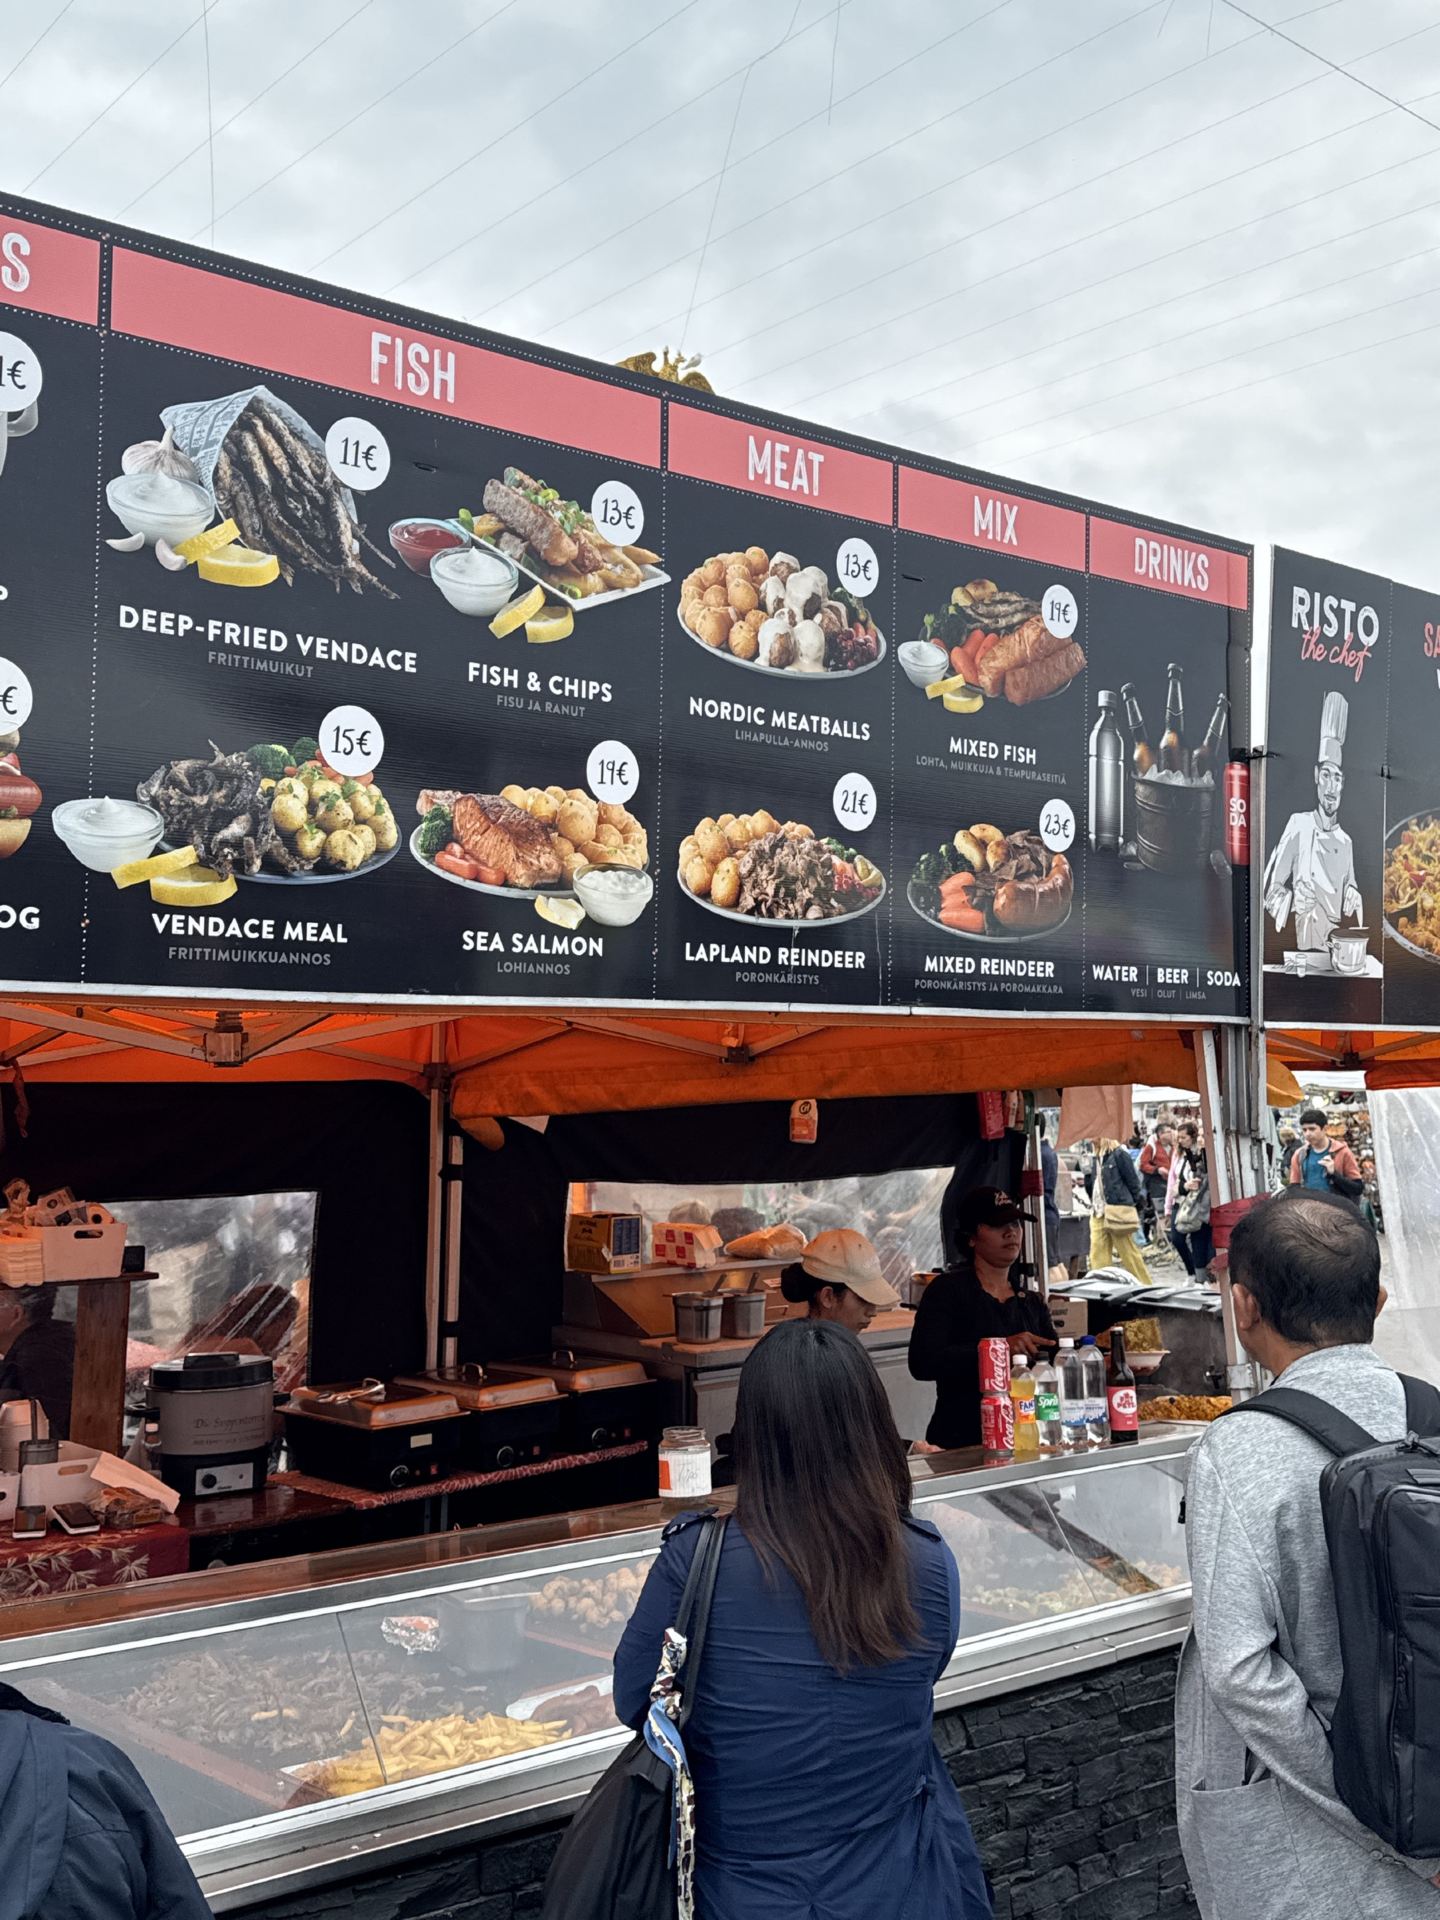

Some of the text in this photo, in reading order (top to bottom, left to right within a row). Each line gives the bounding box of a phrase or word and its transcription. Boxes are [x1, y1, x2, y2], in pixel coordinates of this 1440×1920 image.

[371, 331, 455, 403] FISH
[341, 438, 377, 471] 11€
[748, 435, 825, 496] MEAT
[602, 498, 635, 530] 13€
[974, 495, 1018, 546] MIX
[845, 554, 872, 581] 13€
[1134, 537, 1209, 592] DRINKS
[1047, 602, 1071, 623] 19€
[1291, 586, 1380, 647] RISTO
[119, 604, 417, 676] DEEP-FRIED VENDACE
[208, 651, 314, 678] FRITTIMUIKUT
[1301, 626, 1372, 683] the chef
[468, 661, 613, 703] FISH & CHIPS
[496, 694, 586, 717] FISU JA RANUT
[689, 696, 871, 741] NORDIC MEATBALLS
[331, 725, 371, 756] 15€
[735, 729, 830, 752] LIHAPULLA-ANNOS
[949, 736, 1036, 765] MIXED FISH
[598, 759, 629, 786] 19€
[915, 754, 948, 770] LOHTA,
[950, 760, 995, 775] MUIKKUJA
[841, 790, 868, 815] 21€
[1229, 797, 1247, 813] SO
[1044, 812, 1070, 838] 23€
[1229, 812, 1247, 828] DA
[151, 913, 348, 943] VENDACE MEAL
[168, 946, 331, 966] FRITTIMUIKKUANNOS
[462, 930, 603, 957] SEA SALMON
[685, 942, 866, 969] LAPLAND REINDEER
[497, 961, 571, 975] LOHIANNOS
[735, 969, 819, 985] PORONKÄRISTYS
[924, 955, 1055, 978] MIXED REINDEER
[1092, 964, 1241, 987] WATER BEER SODA
[914, 978, 1064, 994] PORONKÄRISTYS JA POROMAKKARA
[1130, 988, 1207, 1000] VESI OLUT LIMSA
